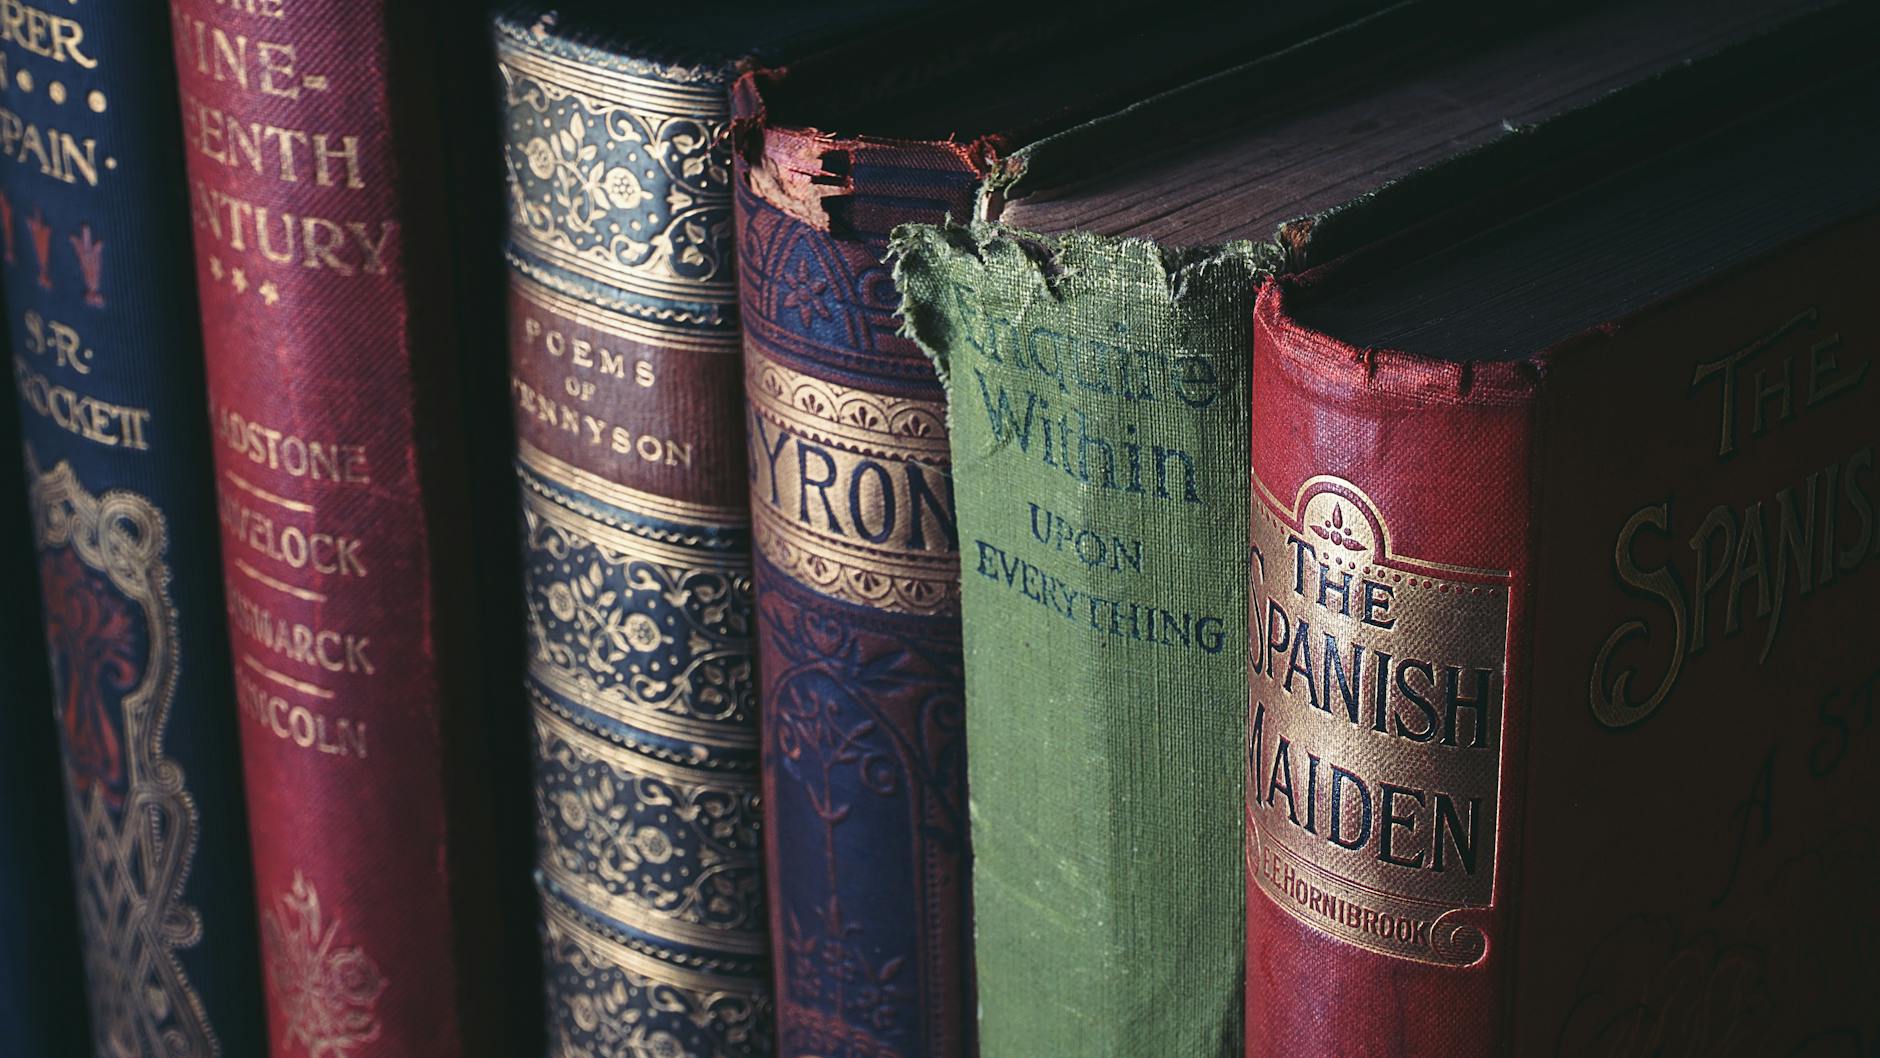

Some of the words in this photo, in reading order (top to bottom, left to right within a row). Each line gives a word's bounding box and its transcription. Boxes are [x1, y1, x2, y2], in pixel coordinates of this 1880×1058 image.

[525, 317, 656, 388] POEMS
[564, 375, 597, 402] OF
[1692, 305, 1873, 457] THE
[751, 411, 958, 551] YRON
[973, 366, 1204, 505] Within
[1027, 501, 1144, 574] UPON
[1287, 533, 1398, 631] THE
[975, 539, 1226, 655] EVERYTHING
[1249, 544, 1494, 750] SPANISH
